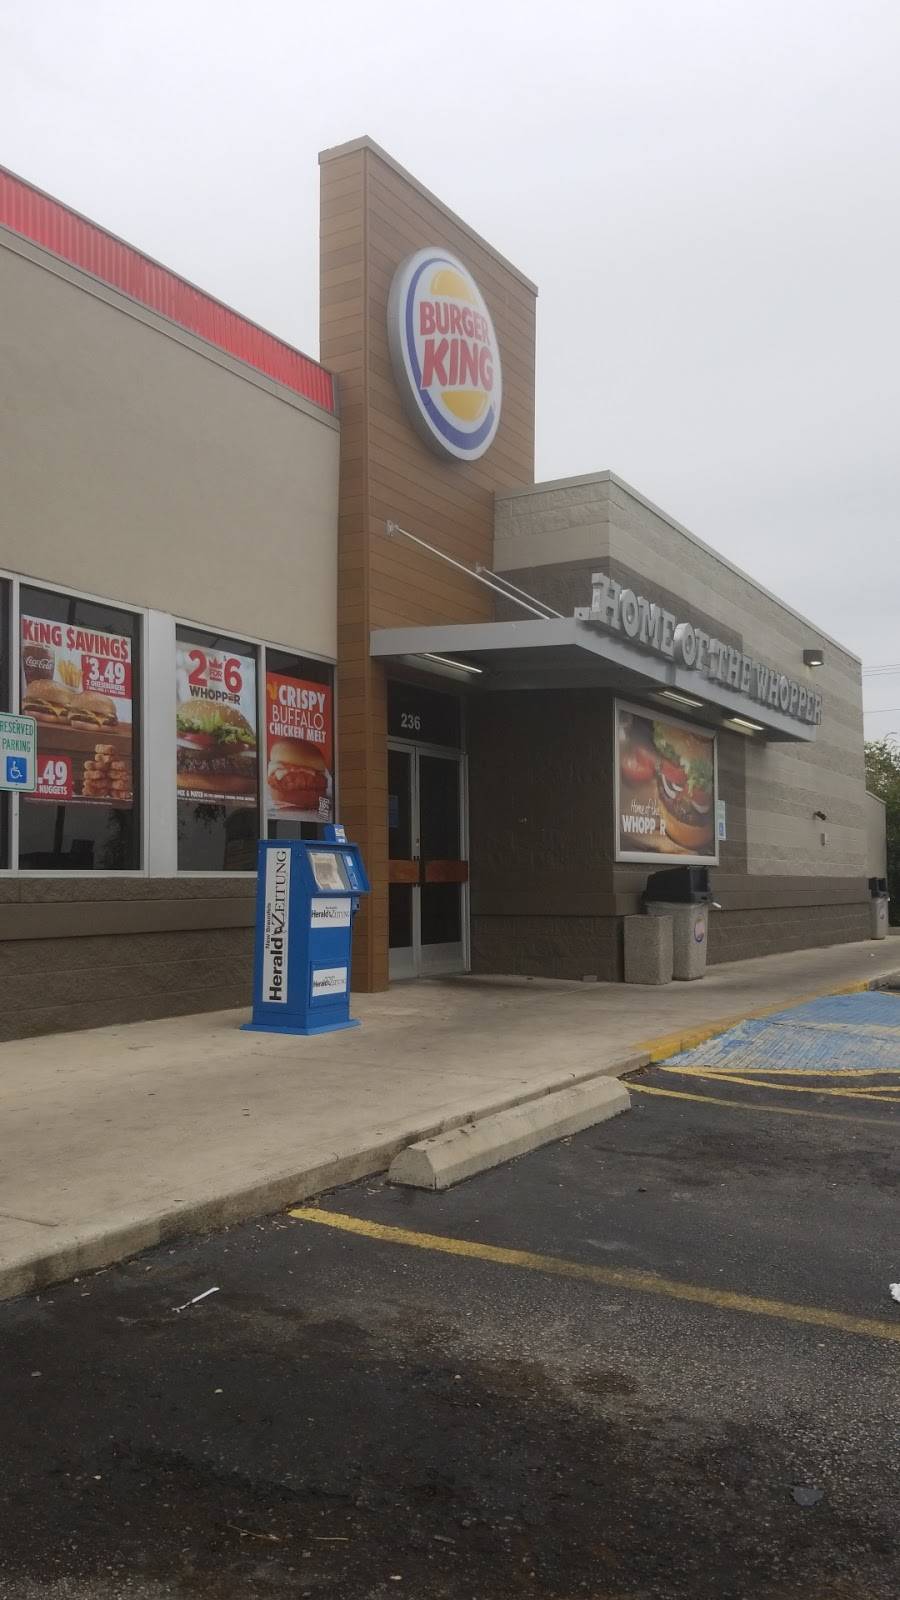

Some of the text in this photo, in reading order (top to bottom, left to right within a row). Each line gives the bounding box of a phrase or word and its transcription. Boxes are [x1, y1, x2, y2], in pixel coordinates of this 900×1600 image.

[419, 301, 491, 346] BURGER
[421, 337, 494, 392] KING
[591, 572, 676, 657] HOME
[710, 638, 751, 693] THE
[753, 661, 823, 726] WHOPPER
[188, 649, 208, 687] 2
[189, 685, 241, 706] WHOPPER
[278, 684, 326, 714] CRISPY
[0, 720, 34, 736] RESERVED
[272, 704, 325, 731] BUFFALO
[400, 713, 421, 730] 236
[2, 738, 31, 753] PARKING
[269, 721, 327, 744] CHICKEN MELT
[37, 760, 68, 786] .49
[39, 785, 68, 795] NUGGETS
[622, 814, 667, 836] WHOPPR
[268, 850, 287, 1001] Herald ZEITUNG
